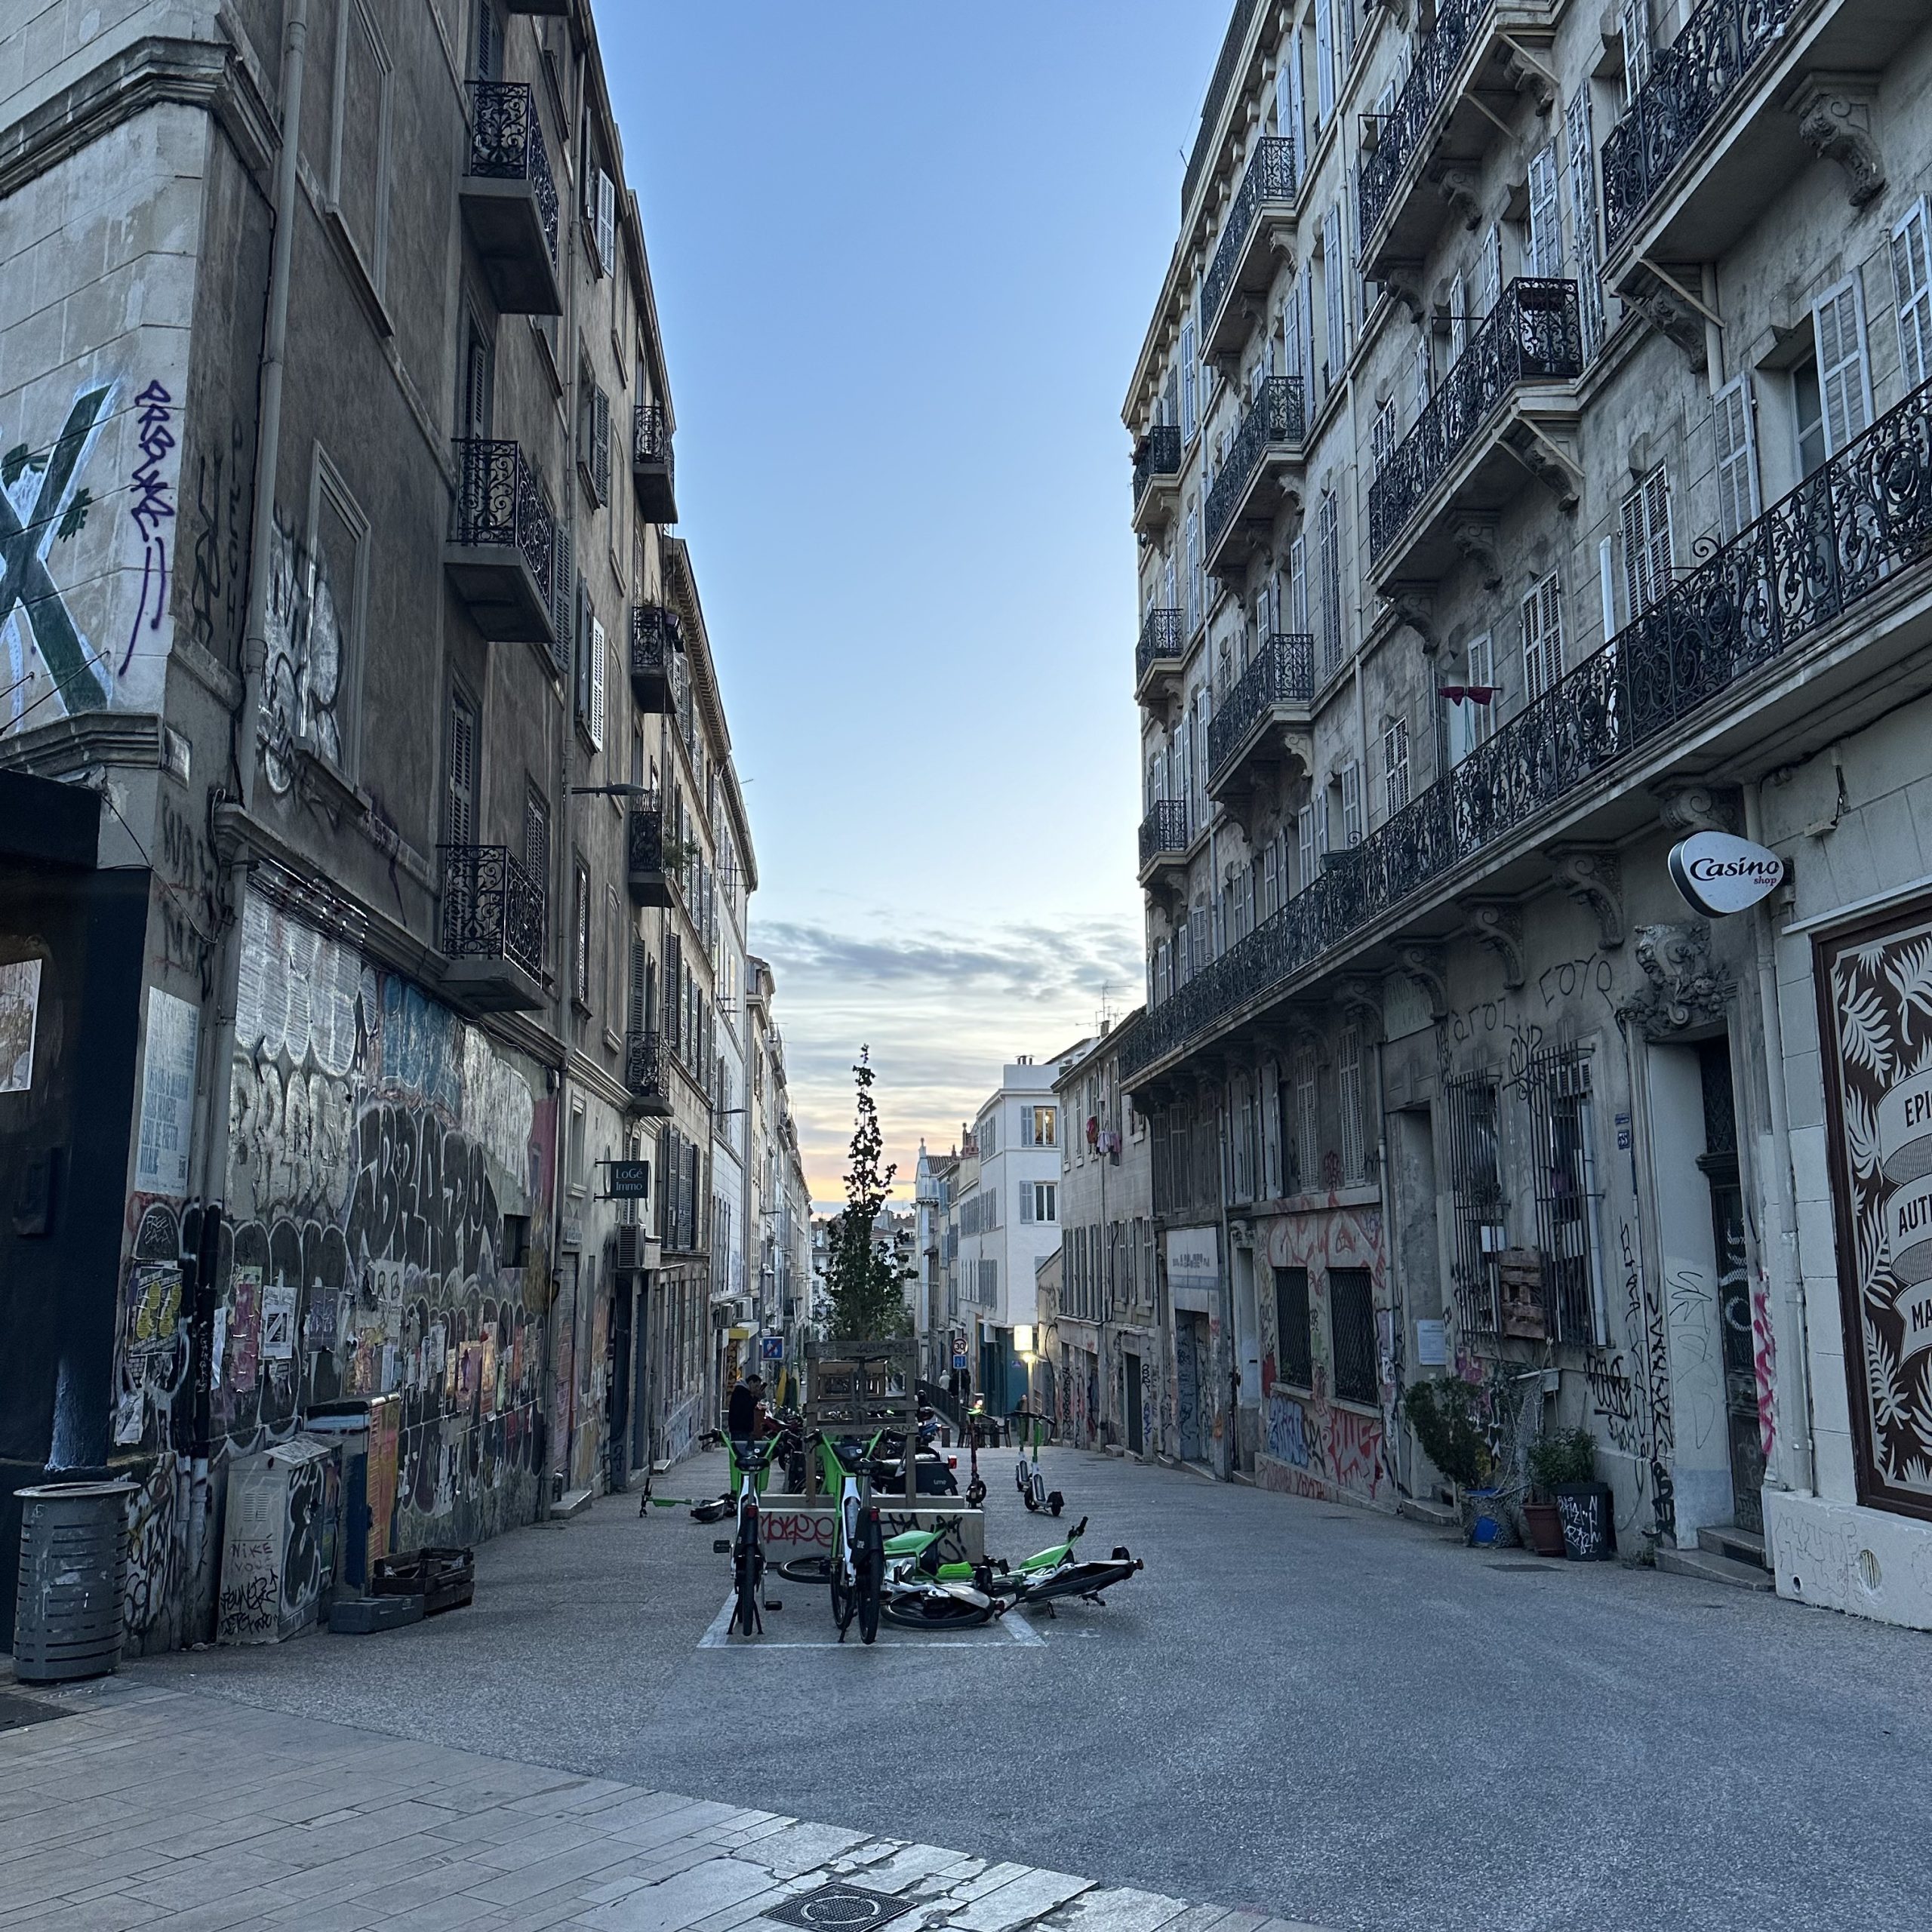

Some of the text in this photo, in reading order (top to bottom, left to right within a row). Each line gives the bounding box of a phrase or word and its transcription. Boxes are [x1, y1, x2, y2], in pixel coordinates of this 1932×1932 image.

[1690, 857, 1780, 881] Casino
[1753, 875, 1777, 887] shop
[1905, 1091, 1932, 1128] EPI
[616, 1168, 643, 1179] LoGé
[616, 1182, 642, 1191] Immo
